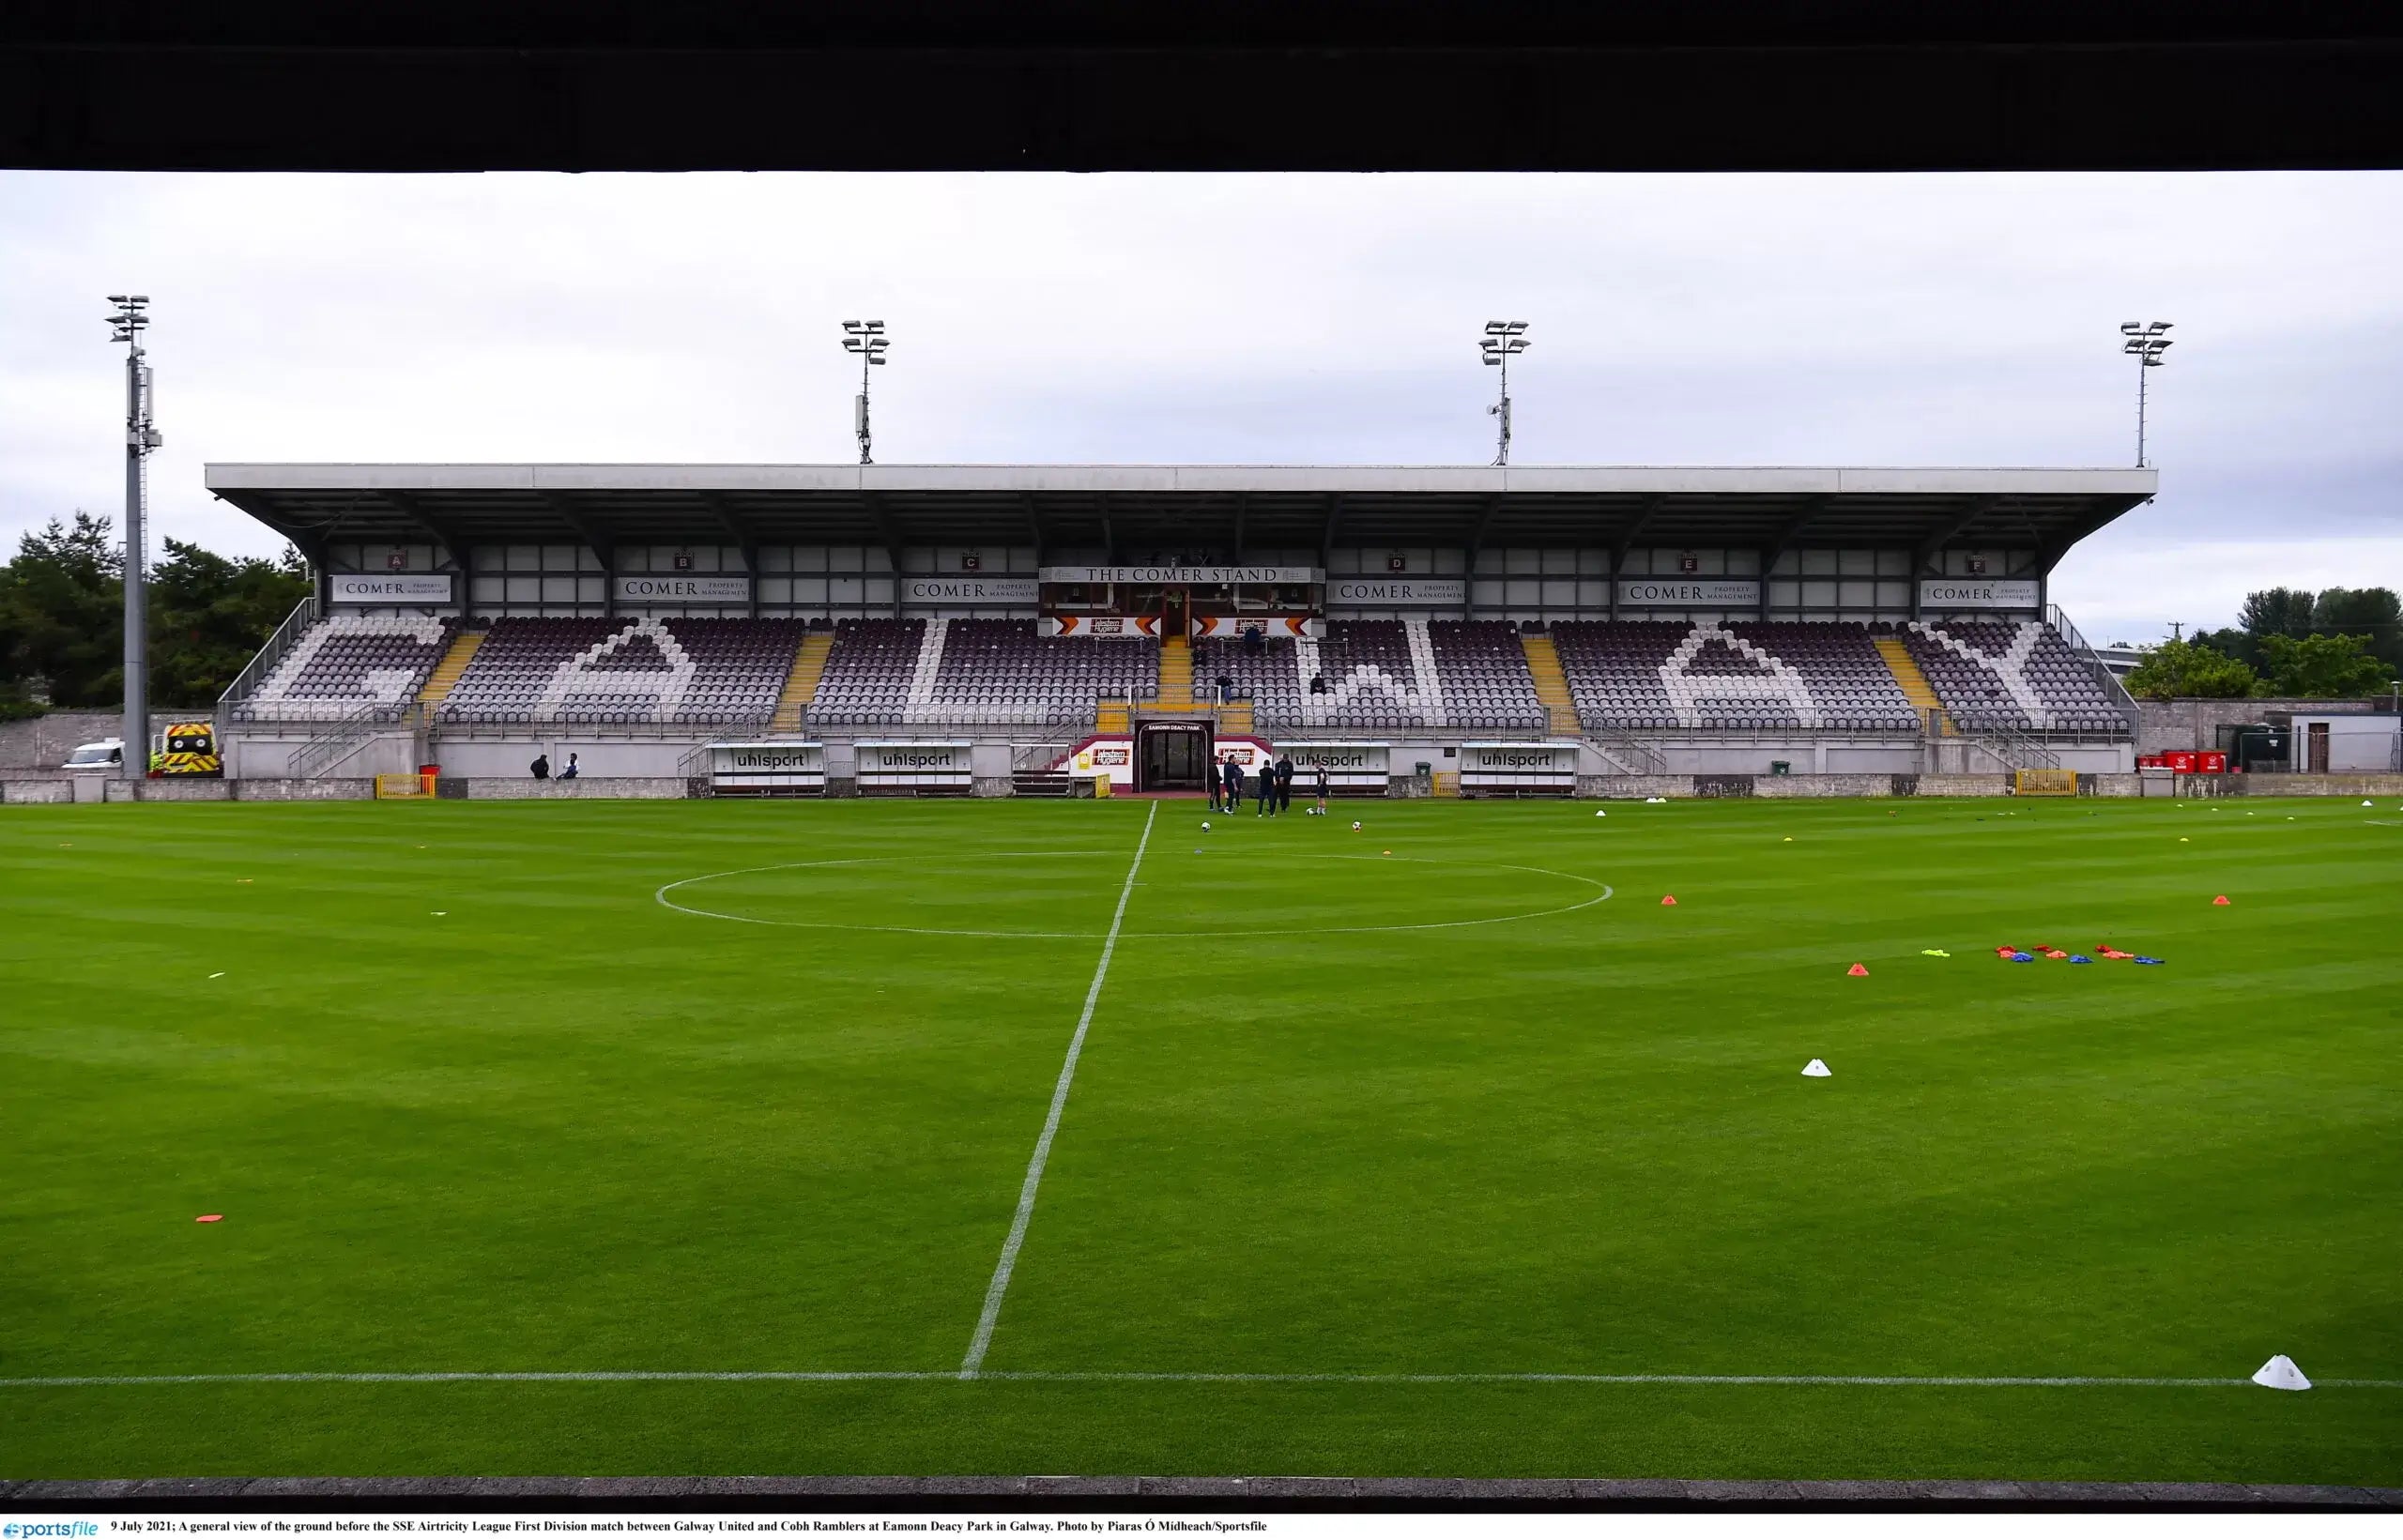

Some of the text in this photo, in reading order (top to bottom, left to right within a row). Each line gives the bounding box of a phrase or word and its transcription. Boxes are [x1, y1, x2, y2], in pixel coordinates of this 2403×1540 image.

[391, 557, 401, 566] A
[1393, 559, 1401, 568] D
[1685, 560, 1692, 569] E
[1973, 561, 1981, 570] F
[1086, 569, 1125, 581] THE
[1132, 569, 1202, 581] COMER
[1212, 569, 1277, 581] STAND
[346, 583, 405, 593] COMER
[625, 582, 697, 594] COMER
[913, 584, 986, 596] COMER
[1340, 585, 1413, 598] COMER
[1630, 587, 1703, 599] COMER
[1933, 588, 1992, 599] COMER
[1098, 749, 1125, 757] Western
[737, 754, 804, 770] uhlsport
[883, 753, 950, 769] uhlsport
[1096, 756, 1125, 766] Hygiene
[1481, 753, 1551, 769] uhlsport
